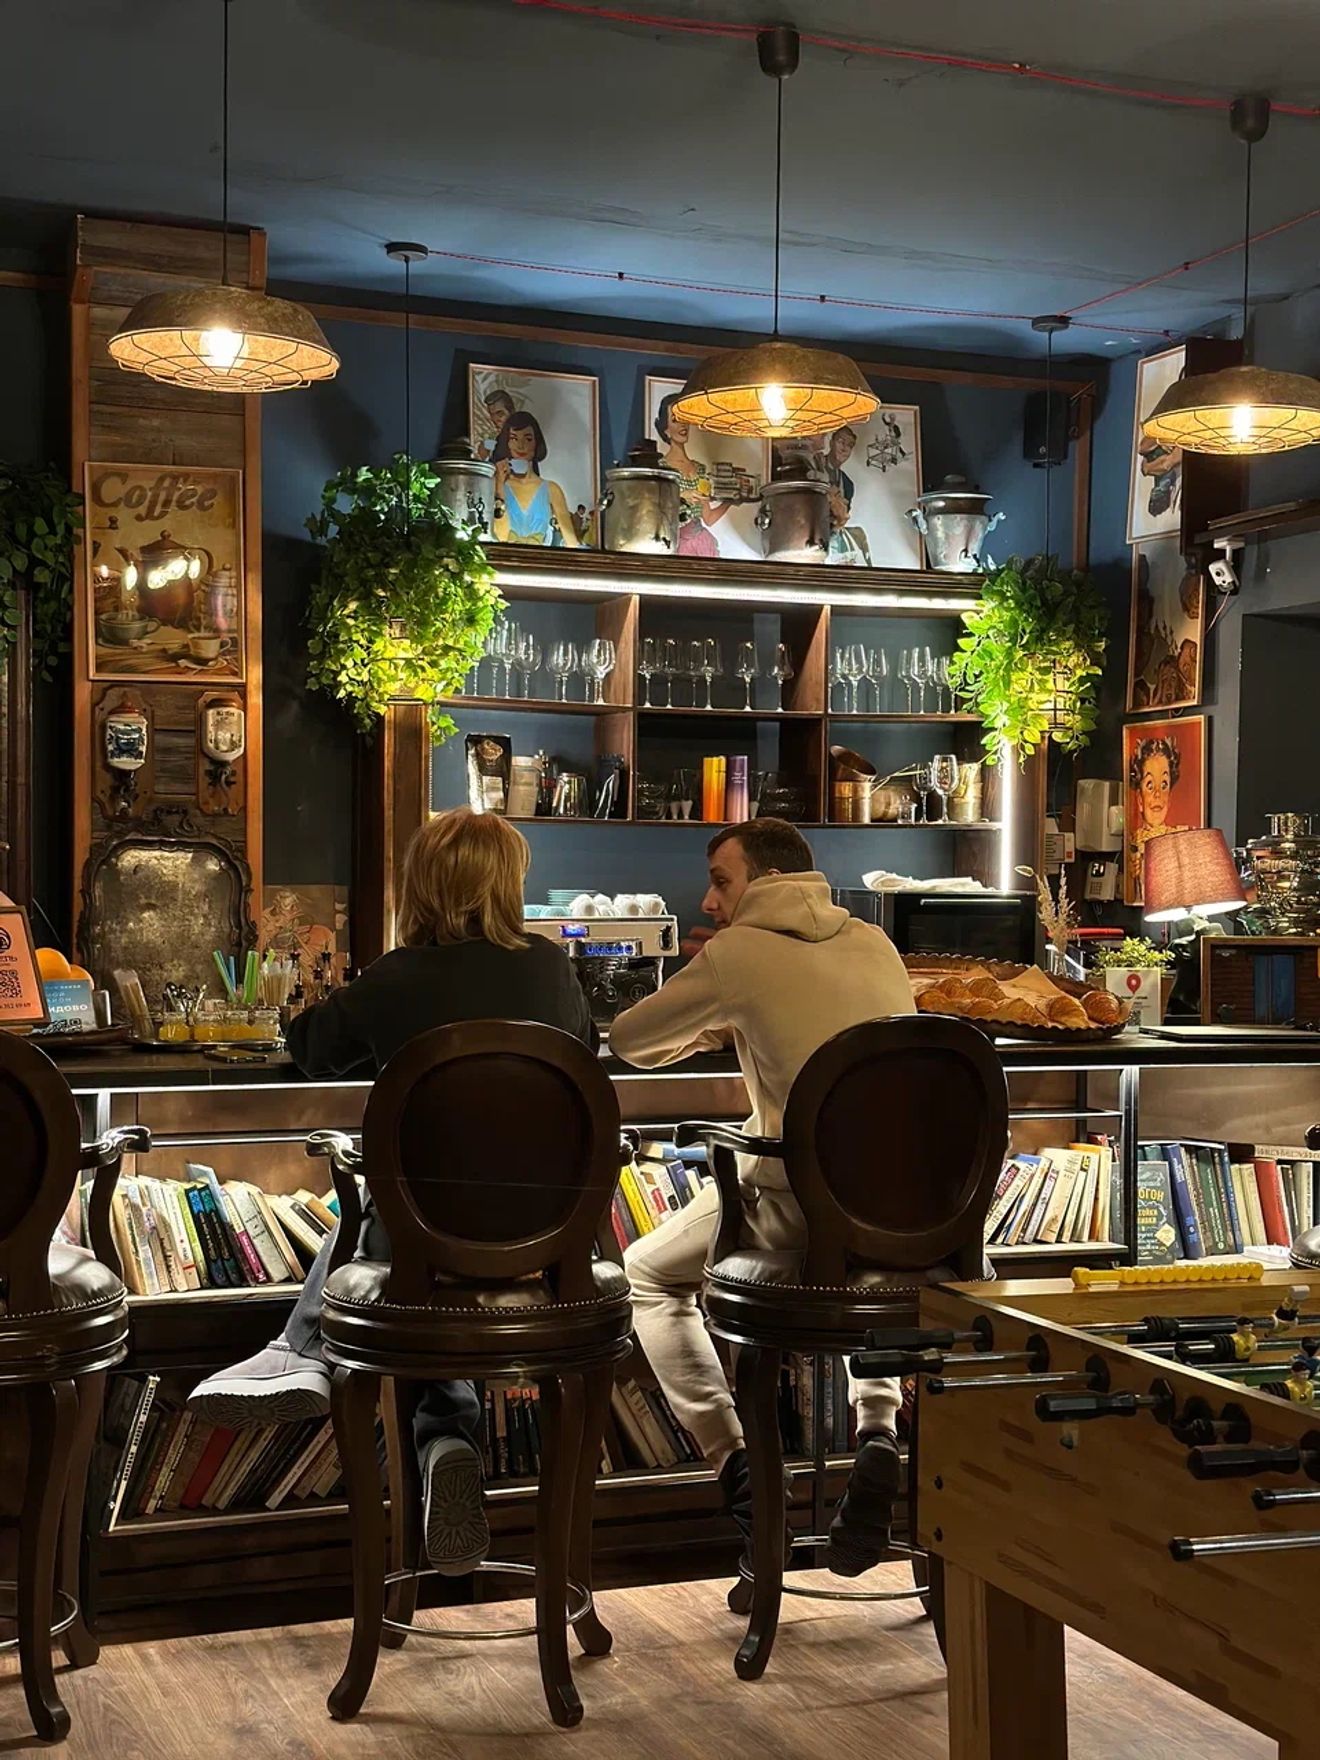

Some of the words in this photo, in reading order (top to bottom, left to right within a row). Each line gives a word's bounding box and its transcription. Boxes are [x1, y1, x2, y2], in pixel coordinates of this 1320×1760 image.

[92, 472, 218, 521] Coffee
[48, 1004, 88, 1014] ИДОВО
[1138, 1187, 1165, 1202] ОГОН
